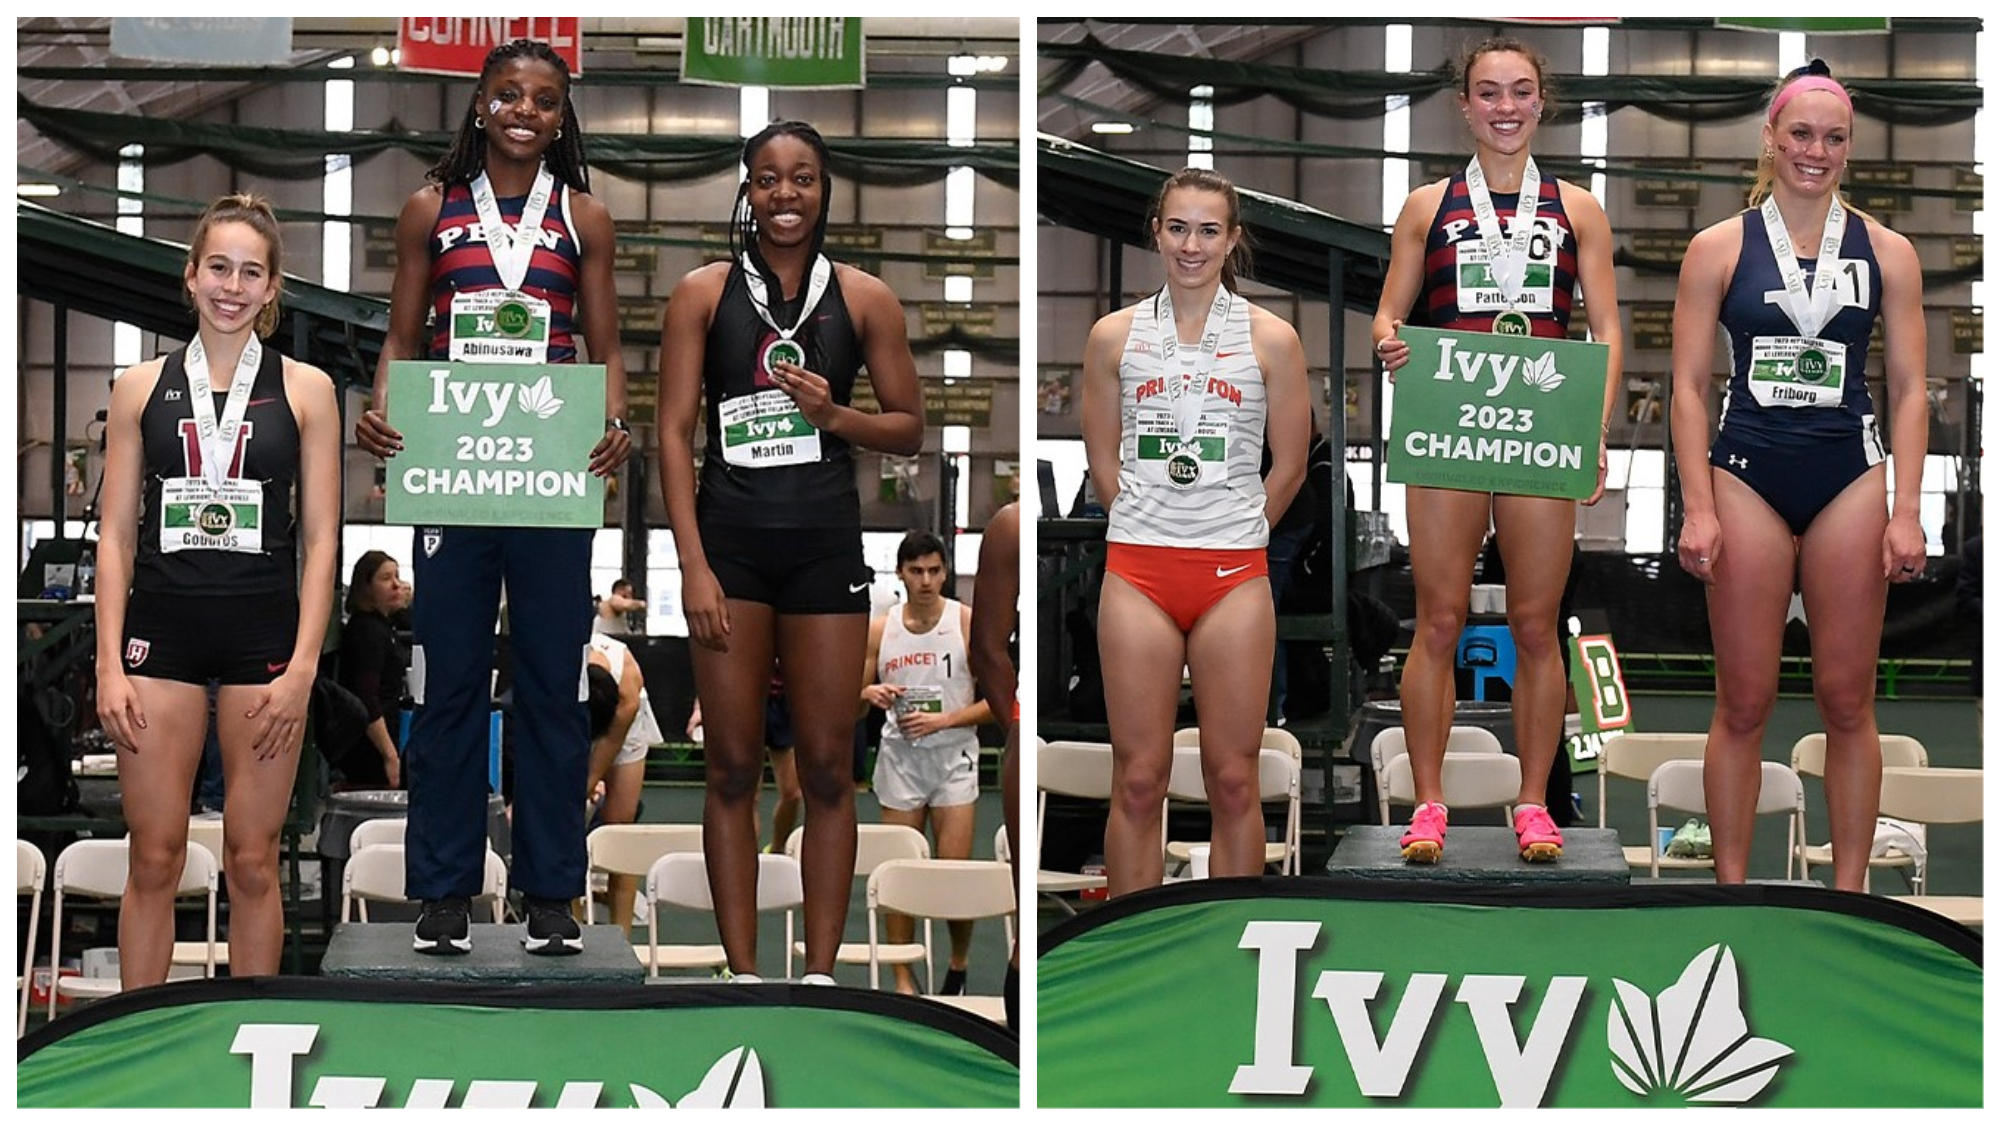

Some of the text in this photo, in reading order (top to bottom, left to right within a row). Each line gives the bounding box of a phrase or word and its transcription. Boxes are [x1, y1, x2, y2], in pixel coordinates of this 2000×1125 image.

[1843, 262, 1860, 303] 1
[1475, 291, 1536, 304] Patteon
[475, 316, 502, 338] Iv
[463, 342, 533, 357] Abinusawa
[1433, 337, 1520, 397] Ivy
[1775, 362, 1798, 381] Iv
[1806, 358, 1824, 370] IVY
[428, 369, 516, 428] Ivy
[1136, 374, 1242, 408] PRITON
[1772, 386, 1817, 403] Friborg
[746, 421, 777, 439] Ivy
[1458, 403, 1534, 432] 2023
[456, 435, 534, 463] 2023
[751, 443, 794, 459] Martin
[1405, 431, 1582, 470] CHAMPION
[402, 467, 587, 497] CHAMPION
[129, 644, 144, 662] H
[885, 652, 938, 674] PRINCET
[942, 653, 951, 678] 1
[1580, 639, 1629, 724] B
[1227, 921, 1588, 1108] Ivy
